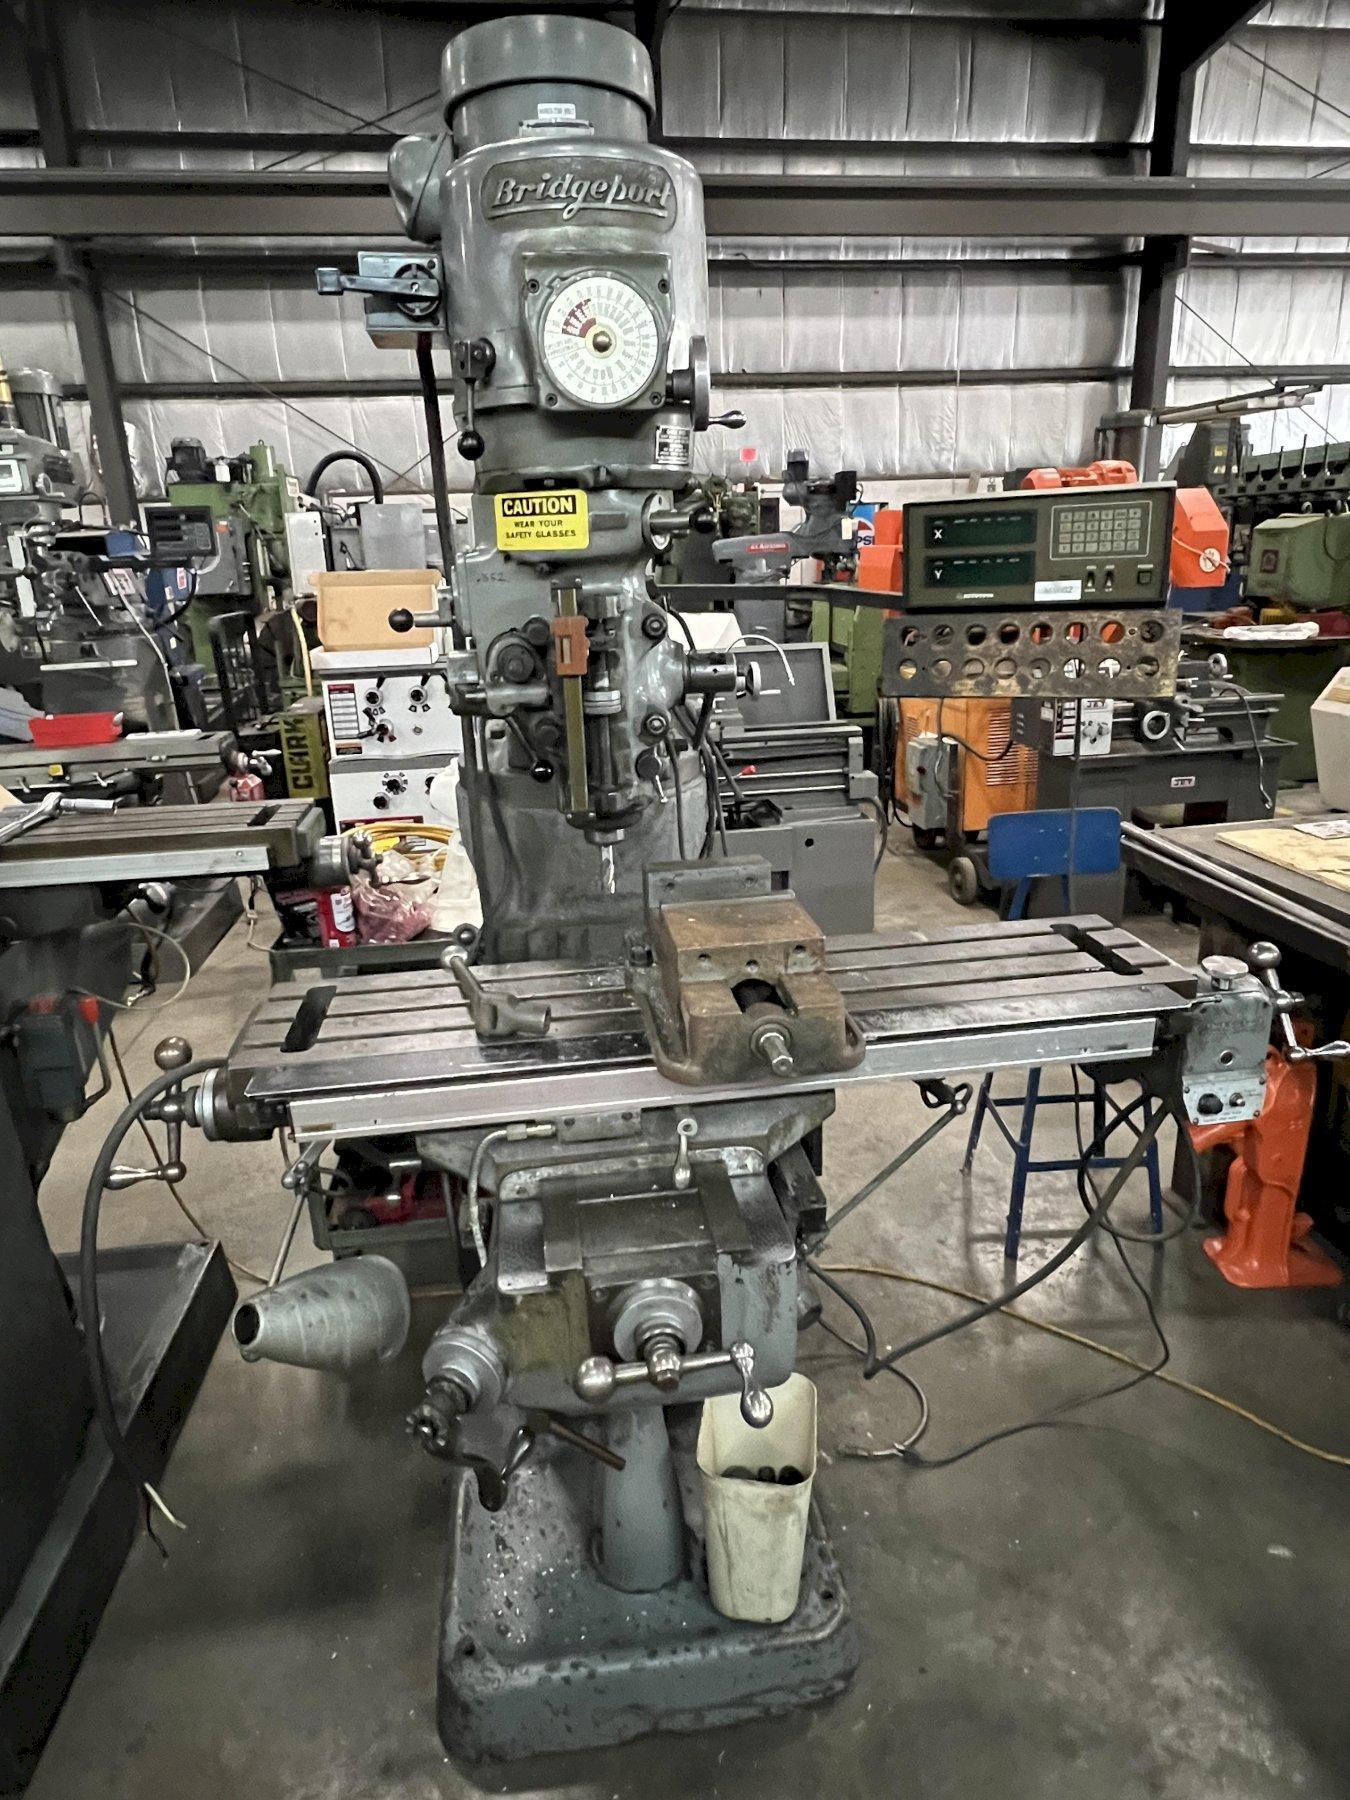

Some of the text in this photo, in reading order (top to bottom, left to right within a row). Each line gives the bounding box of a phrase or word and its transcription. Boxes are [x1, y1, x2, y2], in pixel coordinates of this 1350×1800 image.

[492, 172, 671, 221] Bridgeport
[503, 496, 573, 515] CAUTION
[514, 519, 563, 528] WEAR YOUR
[505, 529, 576, 539] SAFETY GLASSES
[934, 529, 943, 539] X
[934, 569, 943, 579] Y
[282, 716, 313, 790] CLARK
